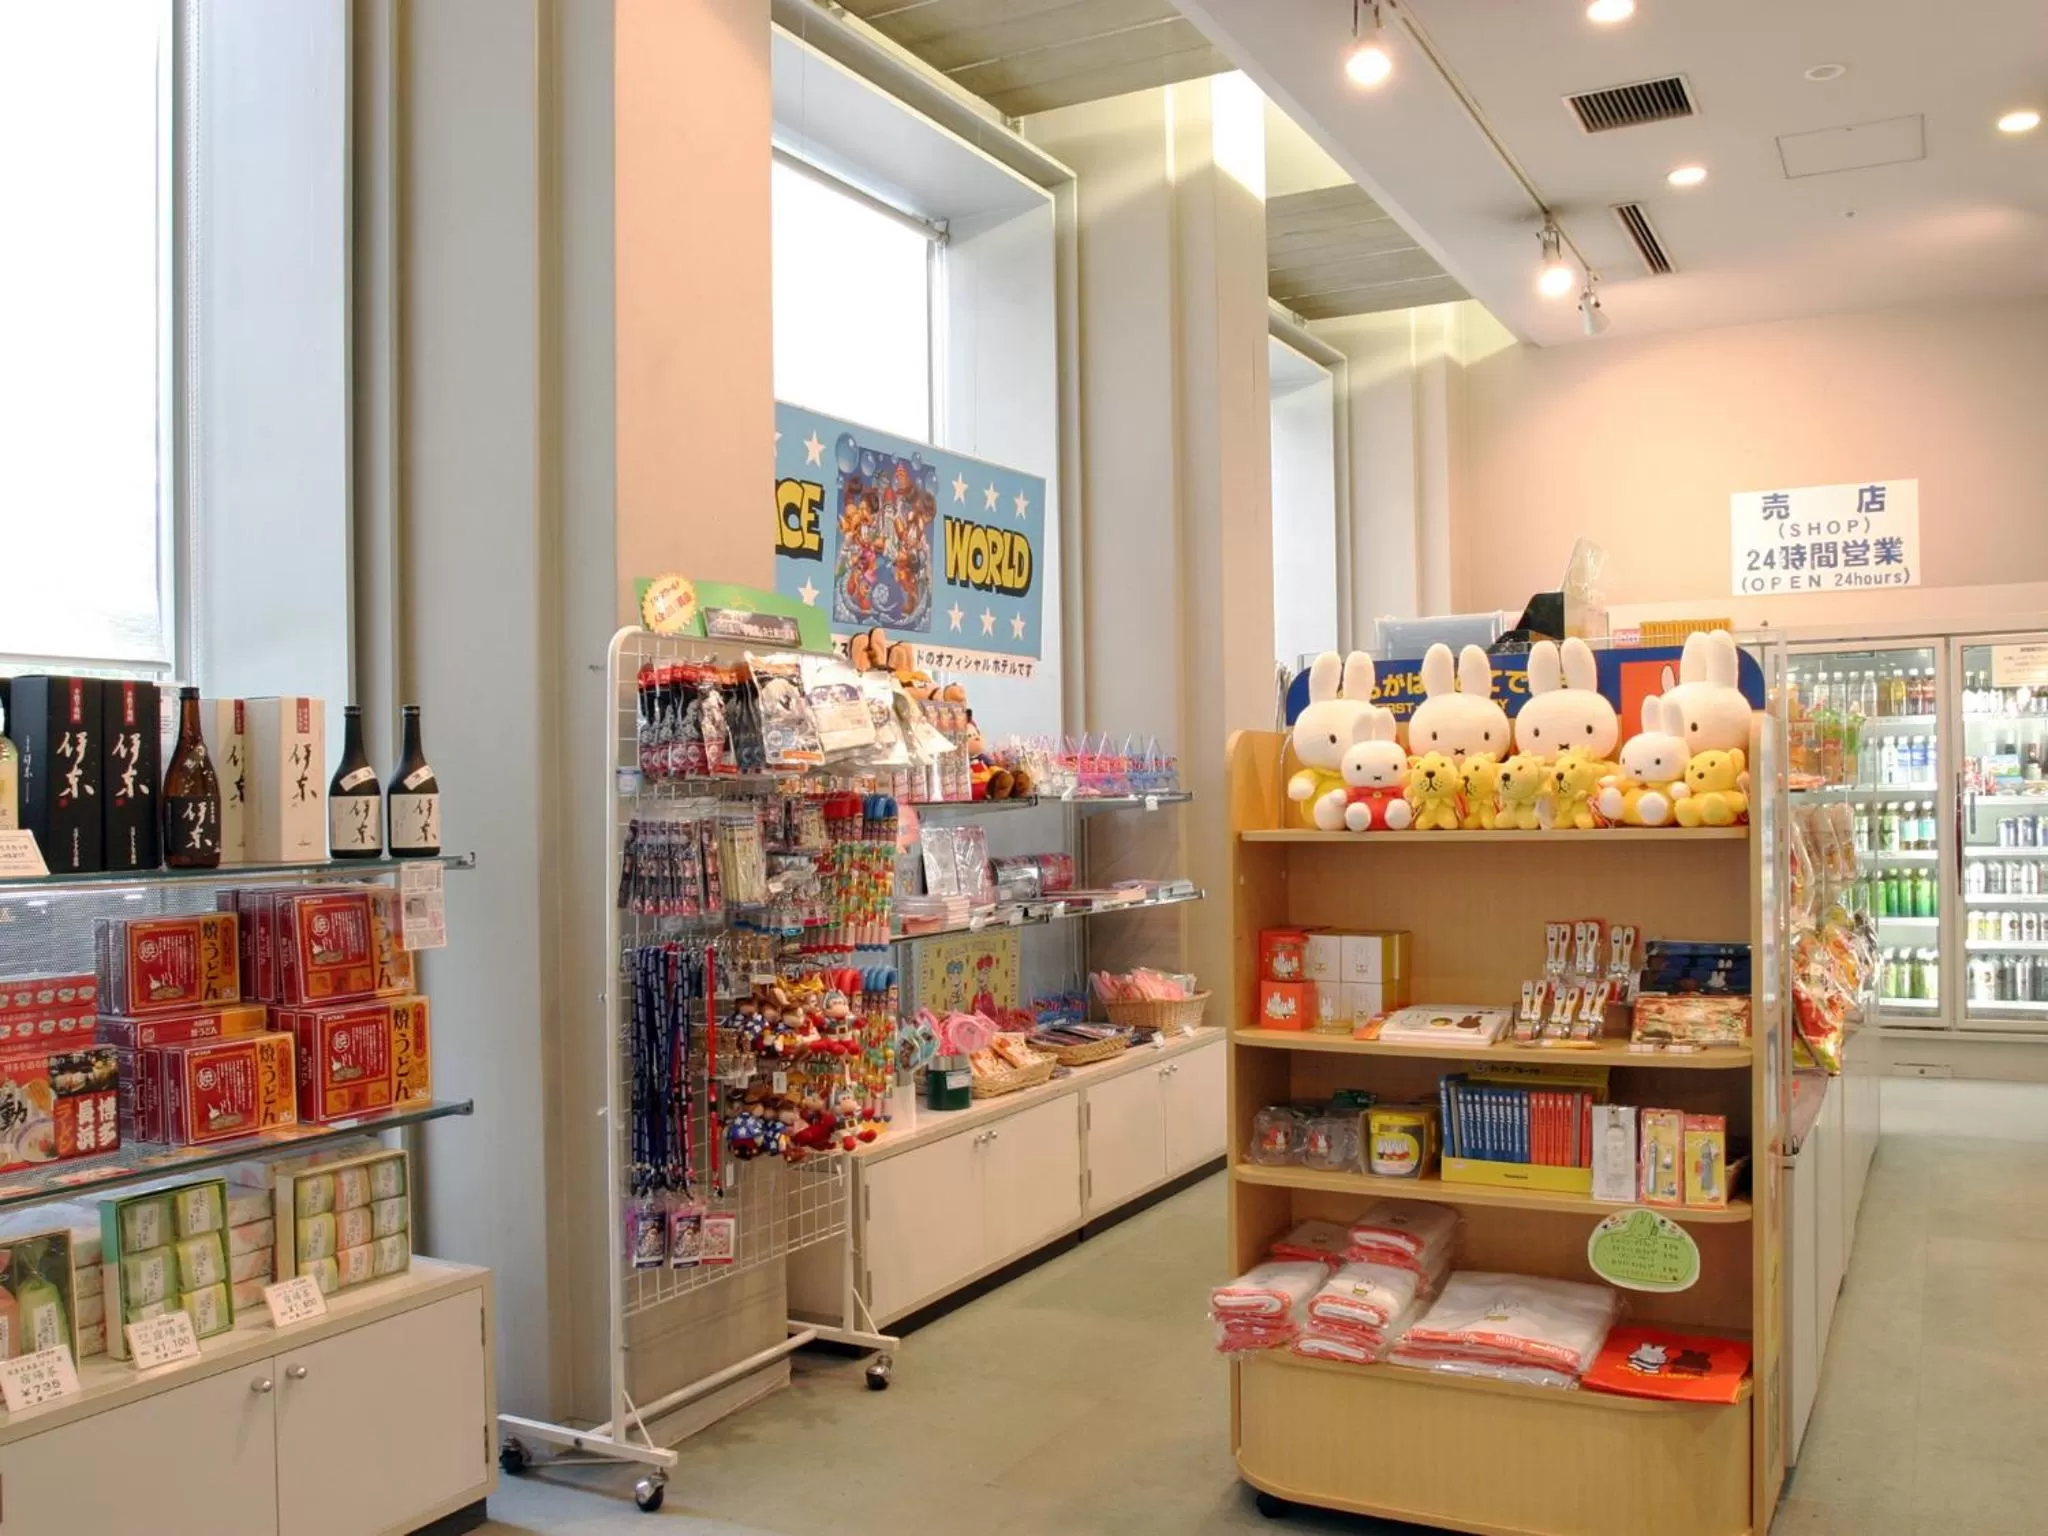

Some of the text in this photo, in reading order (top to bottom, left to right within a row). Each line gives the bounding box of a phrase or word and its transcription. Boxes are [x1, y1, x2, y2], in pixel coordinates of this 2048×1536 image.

[1762, 485, 1886, 520] 売 店
[776, 478, 1033, 598] CE WORLD
[1778, 516, 1871, 540] (SHOP)
[1747, 536, 1904, 572] 24時間営業
[1741, 567, 1911, 594] (OPEN 24hours)
[916, 649, 1033, 678] ドのオフィシャルホテルです
